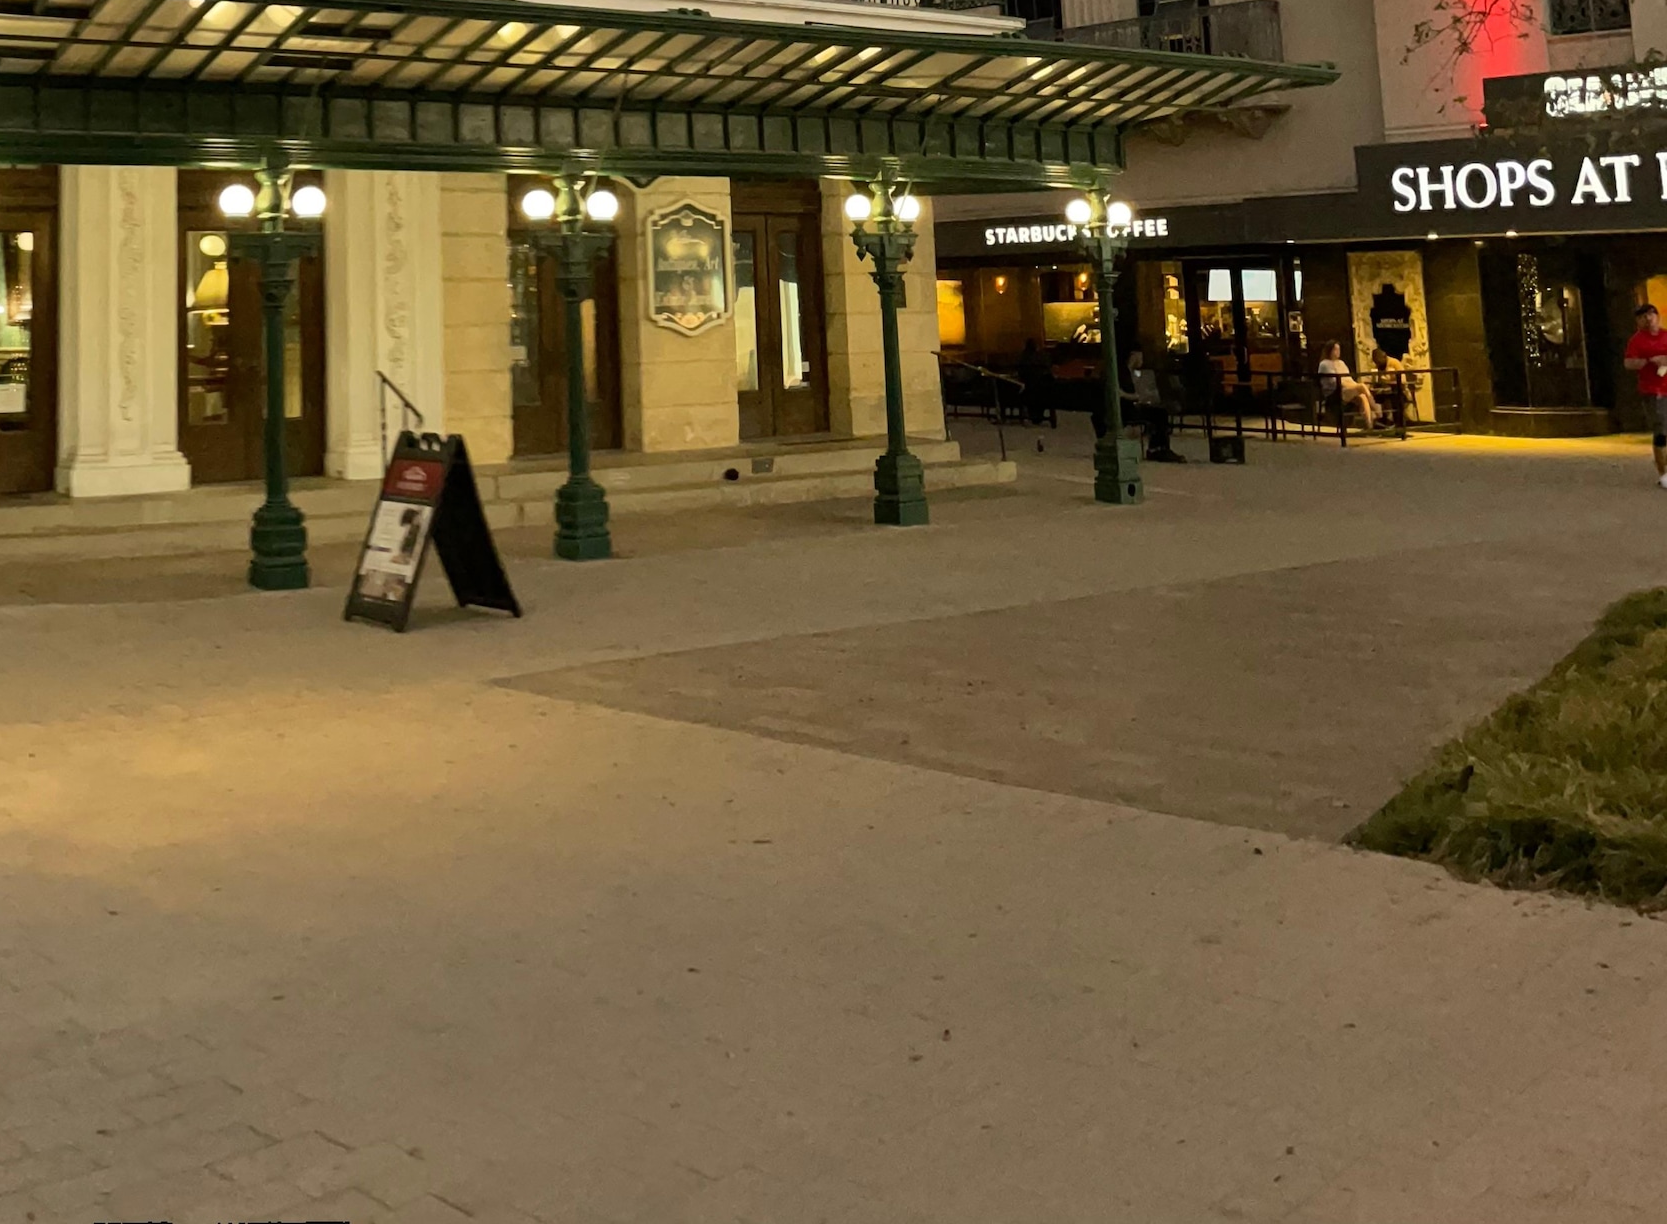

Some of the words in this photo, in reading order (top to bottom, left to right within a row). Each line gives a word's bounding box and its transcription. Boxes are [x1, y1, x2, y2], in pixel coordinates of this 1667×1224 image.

[1391, 157, 1556, 213] SHOPS
[1570, 154, 1642, 205] AT
[1097, 218, 1169, 239] OFFEE
